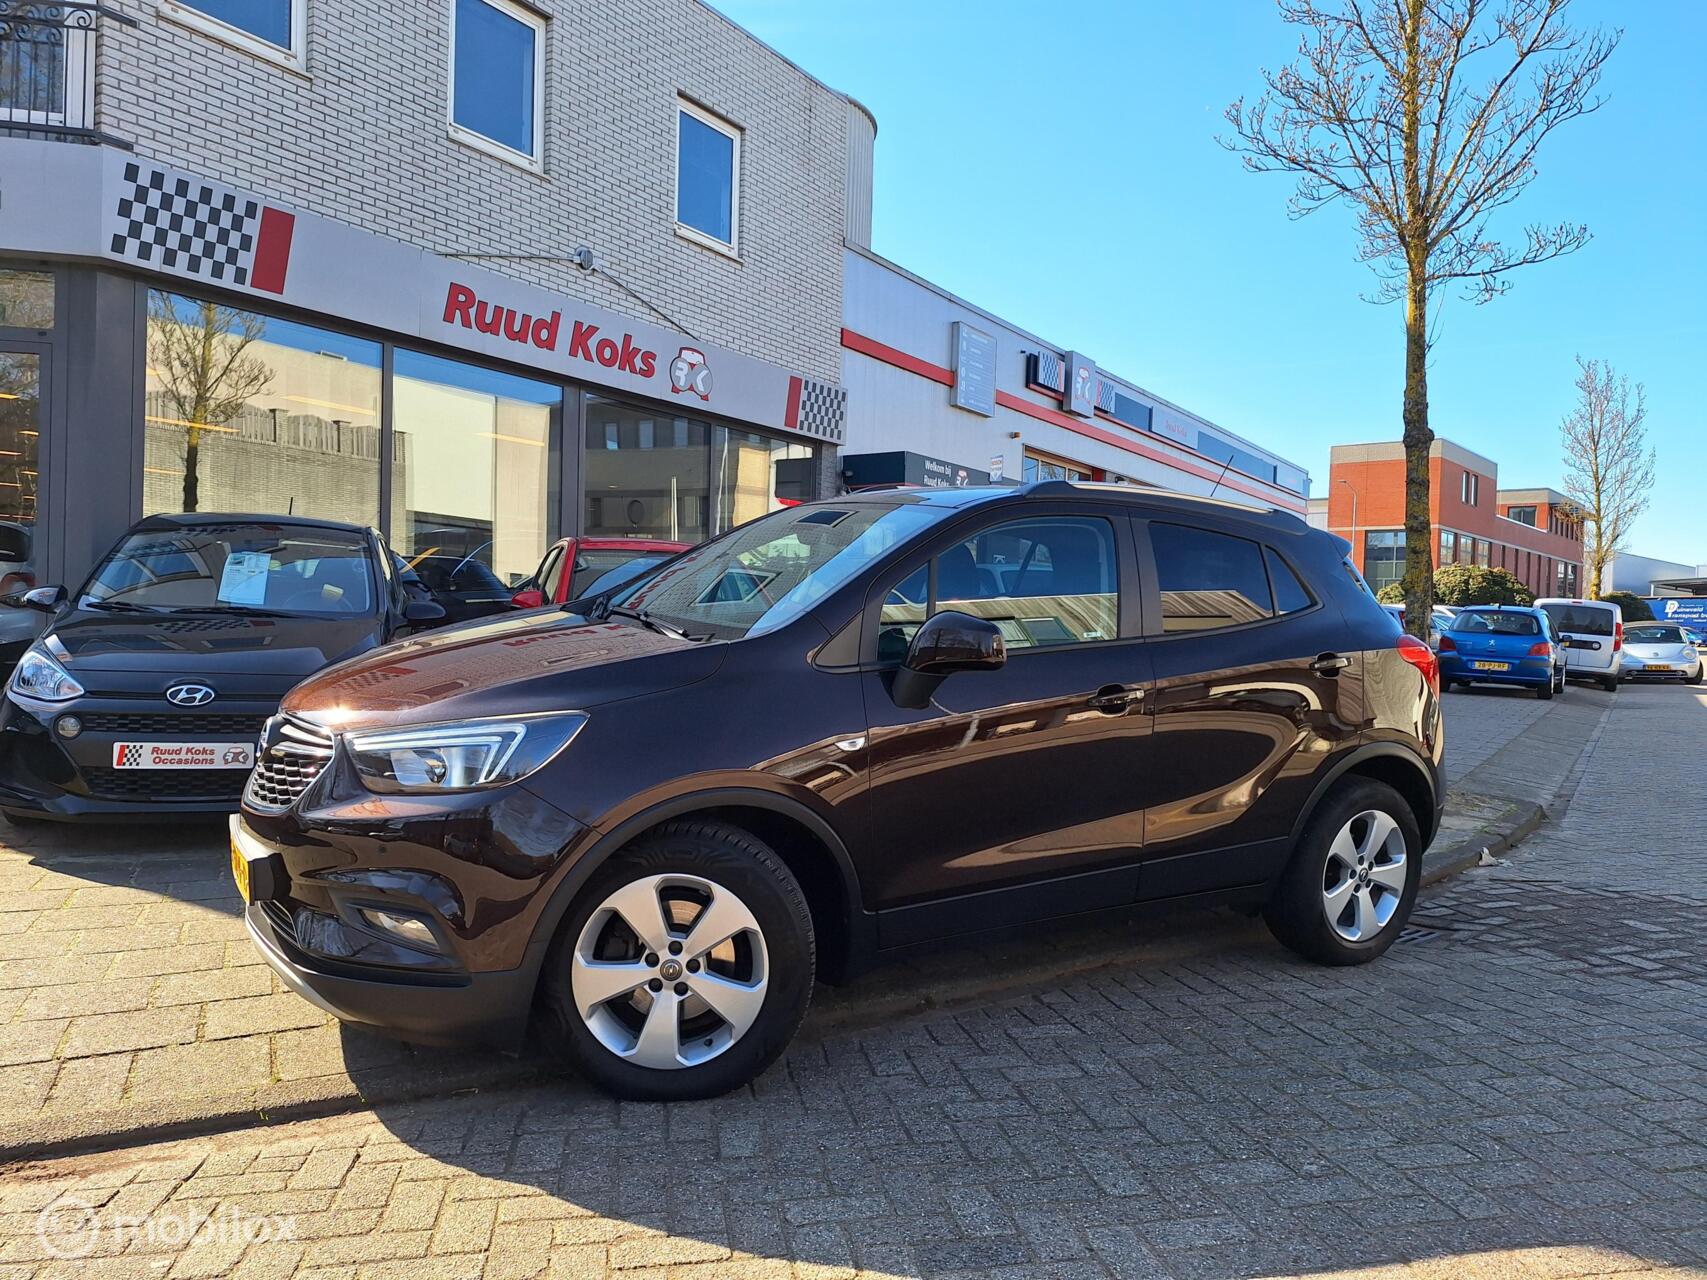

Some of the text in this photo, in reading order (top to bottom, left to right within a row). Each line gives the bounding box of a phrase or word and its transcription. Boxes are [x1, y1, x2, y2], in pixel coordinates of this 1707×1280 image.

[442, 281, 658, 379] Ruud Koks
[924, 459, 945, 474] Welkom
[151, 746, 216, 756] Ruud Koks
[152, 756, 216, 764] Occasions
